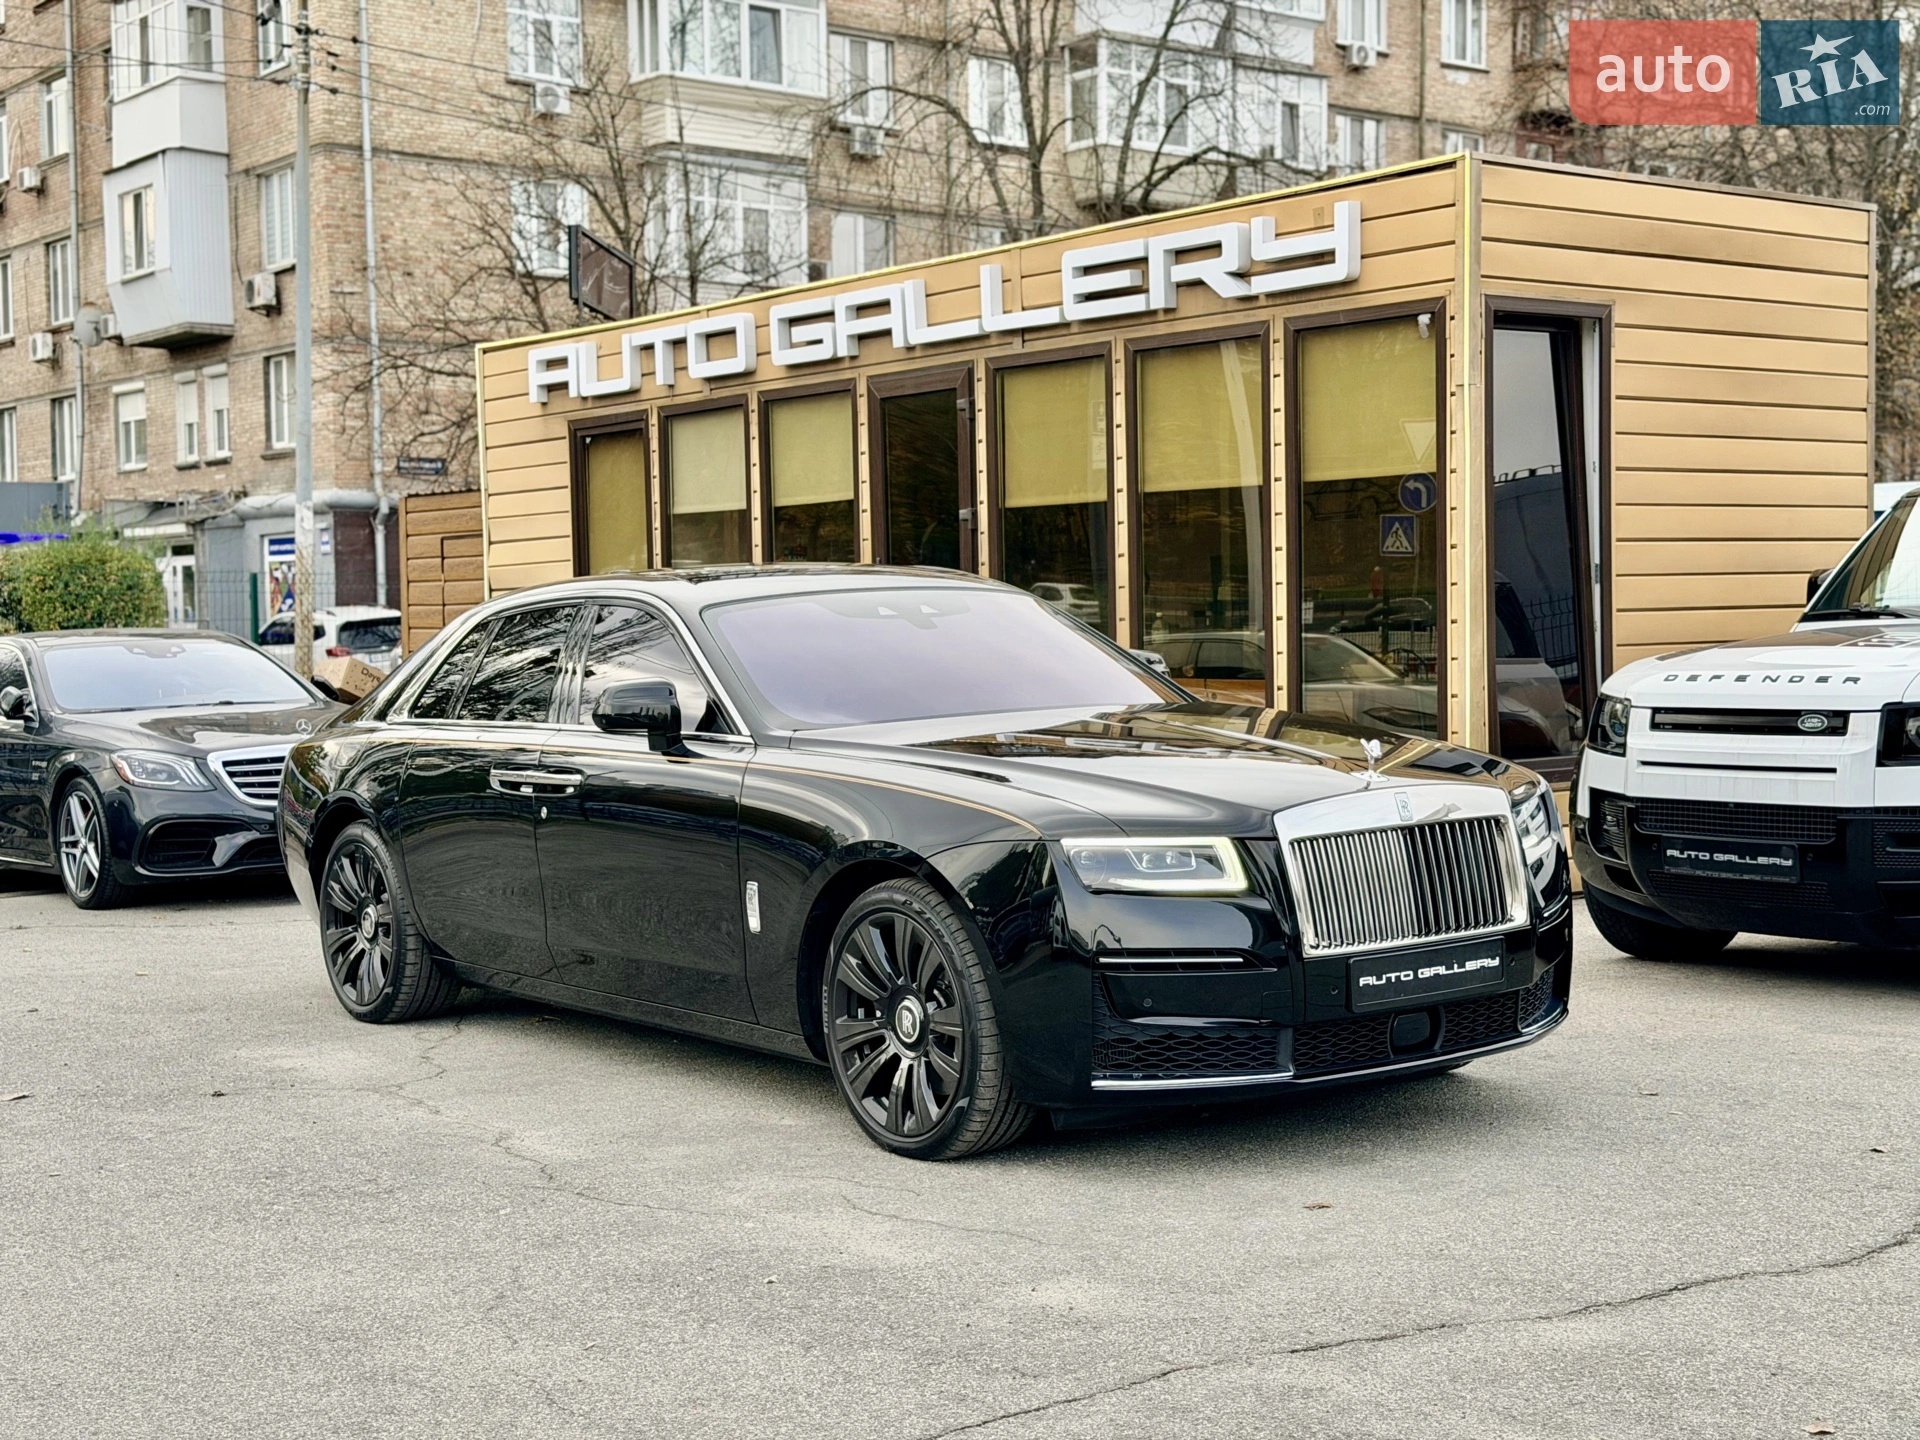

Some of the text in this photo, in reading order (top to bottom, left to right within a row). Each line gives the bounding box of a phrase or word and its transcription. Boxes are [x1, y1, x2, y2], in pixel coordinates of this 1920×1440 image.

[528, 200, 1362, 403] AUTO GALLERY
[1663, 674, 1861, 684] DEFENDER
[1666, 849, 1792, 866] AUTO GALLERY
[1359, 956, 1500, 987] AUTO GALLERY
